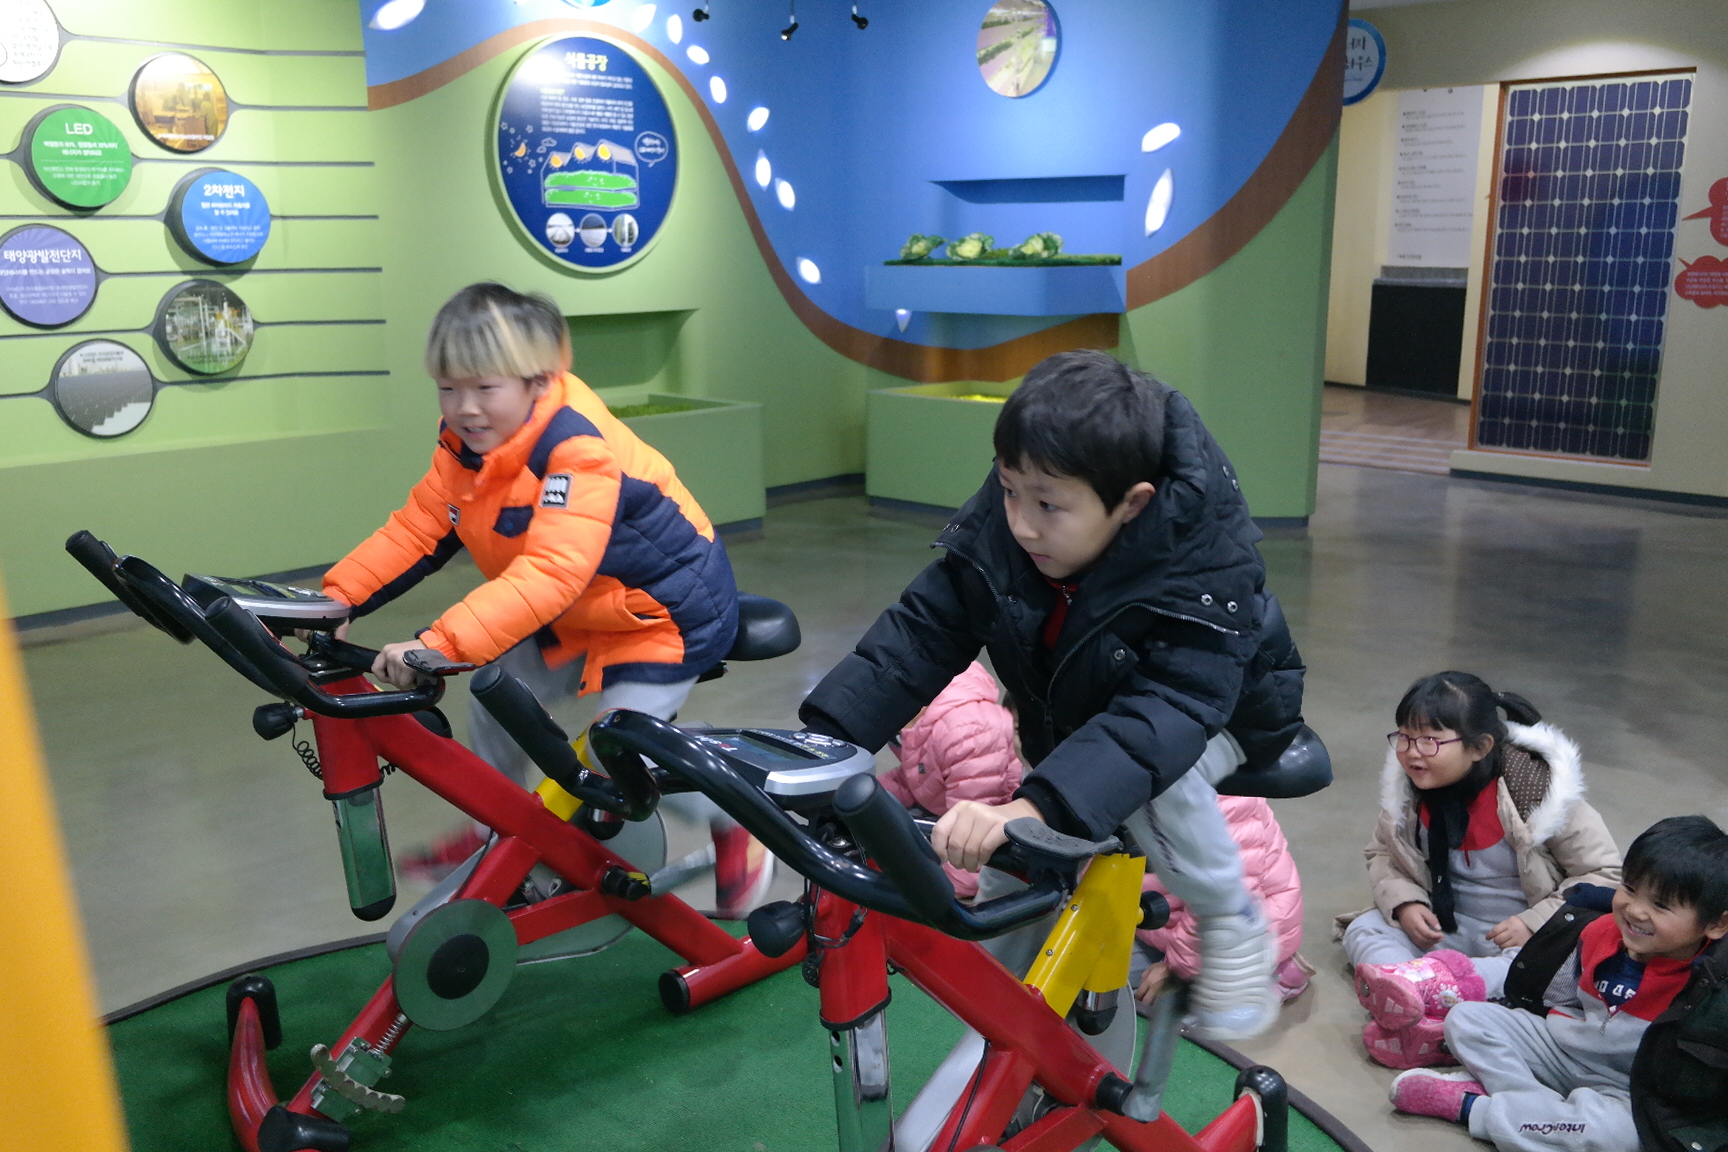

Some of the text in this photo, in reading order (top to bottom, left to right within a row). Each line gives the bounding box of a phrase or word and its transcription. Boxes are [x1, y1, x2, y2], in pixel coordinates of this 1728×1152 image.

[565, 52, 608, 71] 식물공장
[65, 122, 93, 135] LED
[203, 183, 246, 199] 2차전지
[3, 248, 83, 264] 태양광발전단지
